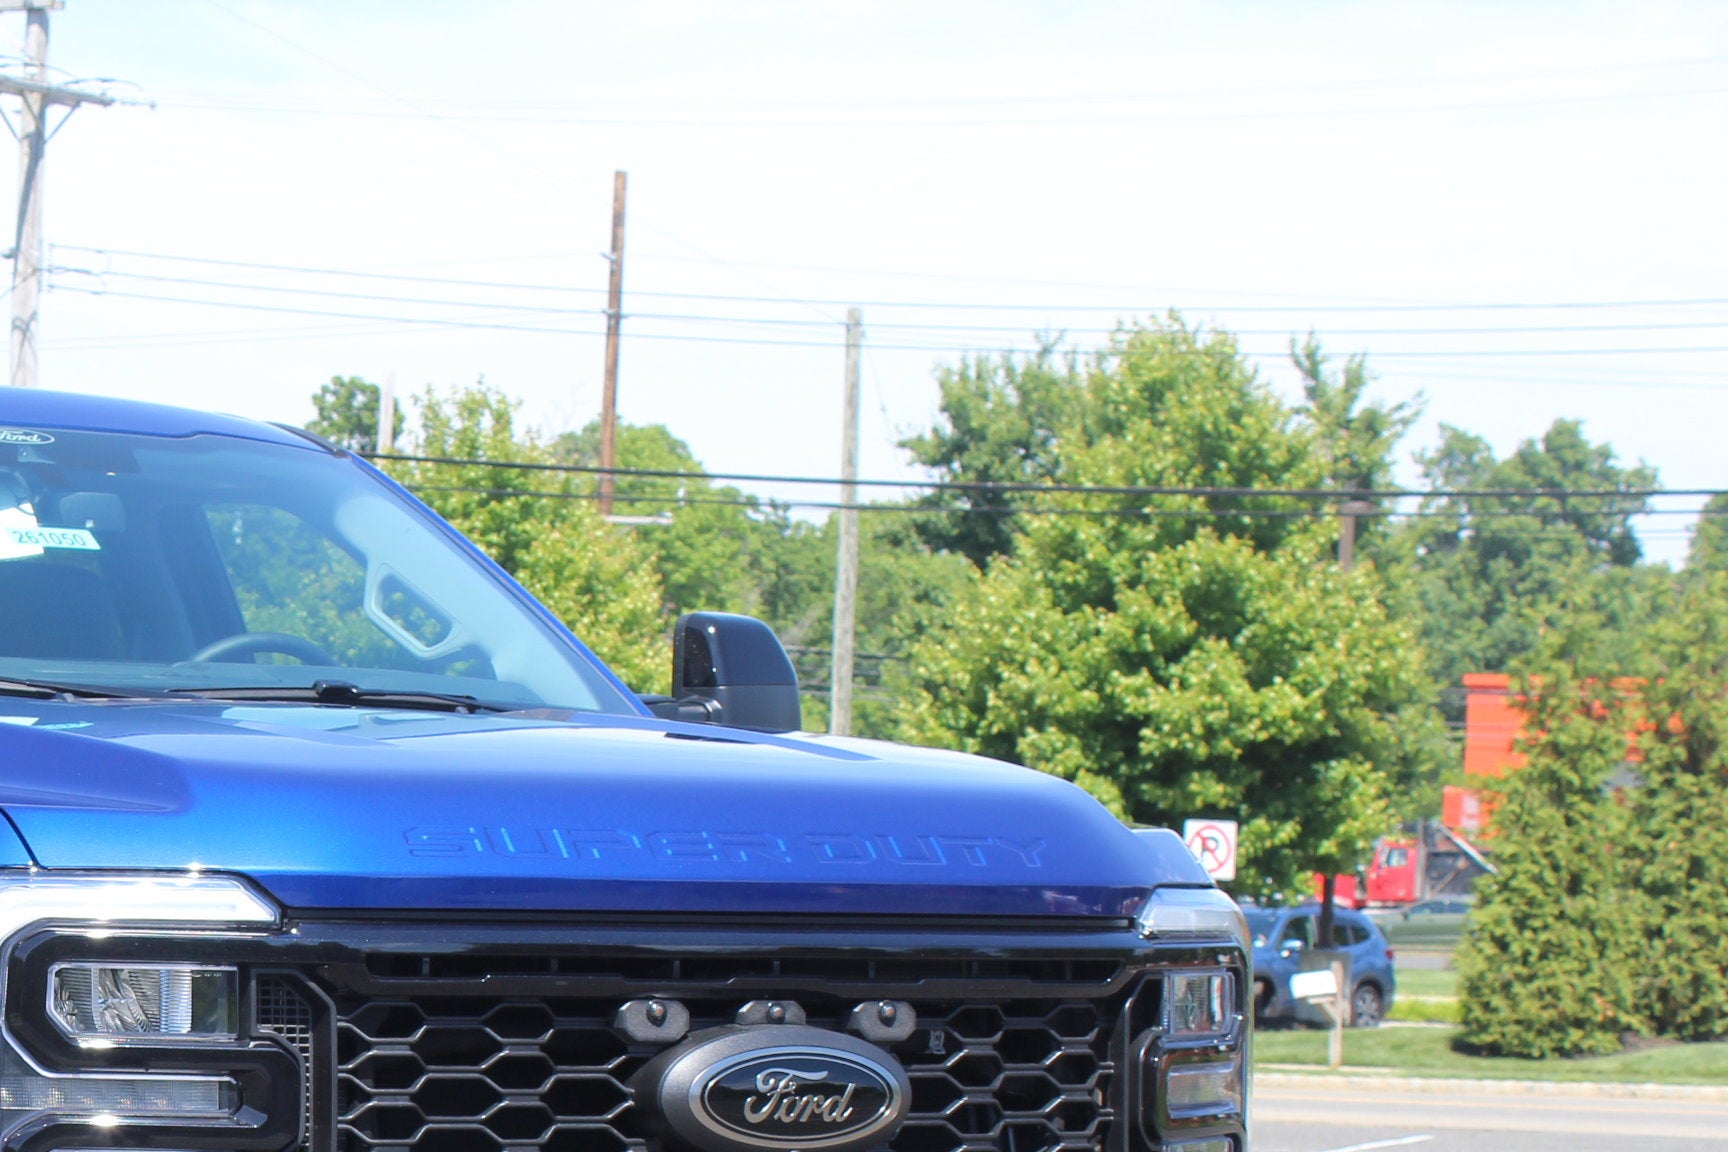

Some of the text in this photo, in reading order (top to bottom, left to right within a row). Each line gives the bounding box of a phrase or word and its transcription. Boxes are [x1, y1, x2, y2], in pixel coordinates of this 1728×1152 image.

[12, 530, 87, 547] 261050
[401, 826, 1048, 868] SUPER DUTY
[743, 1067, 857, 1124] Ford
